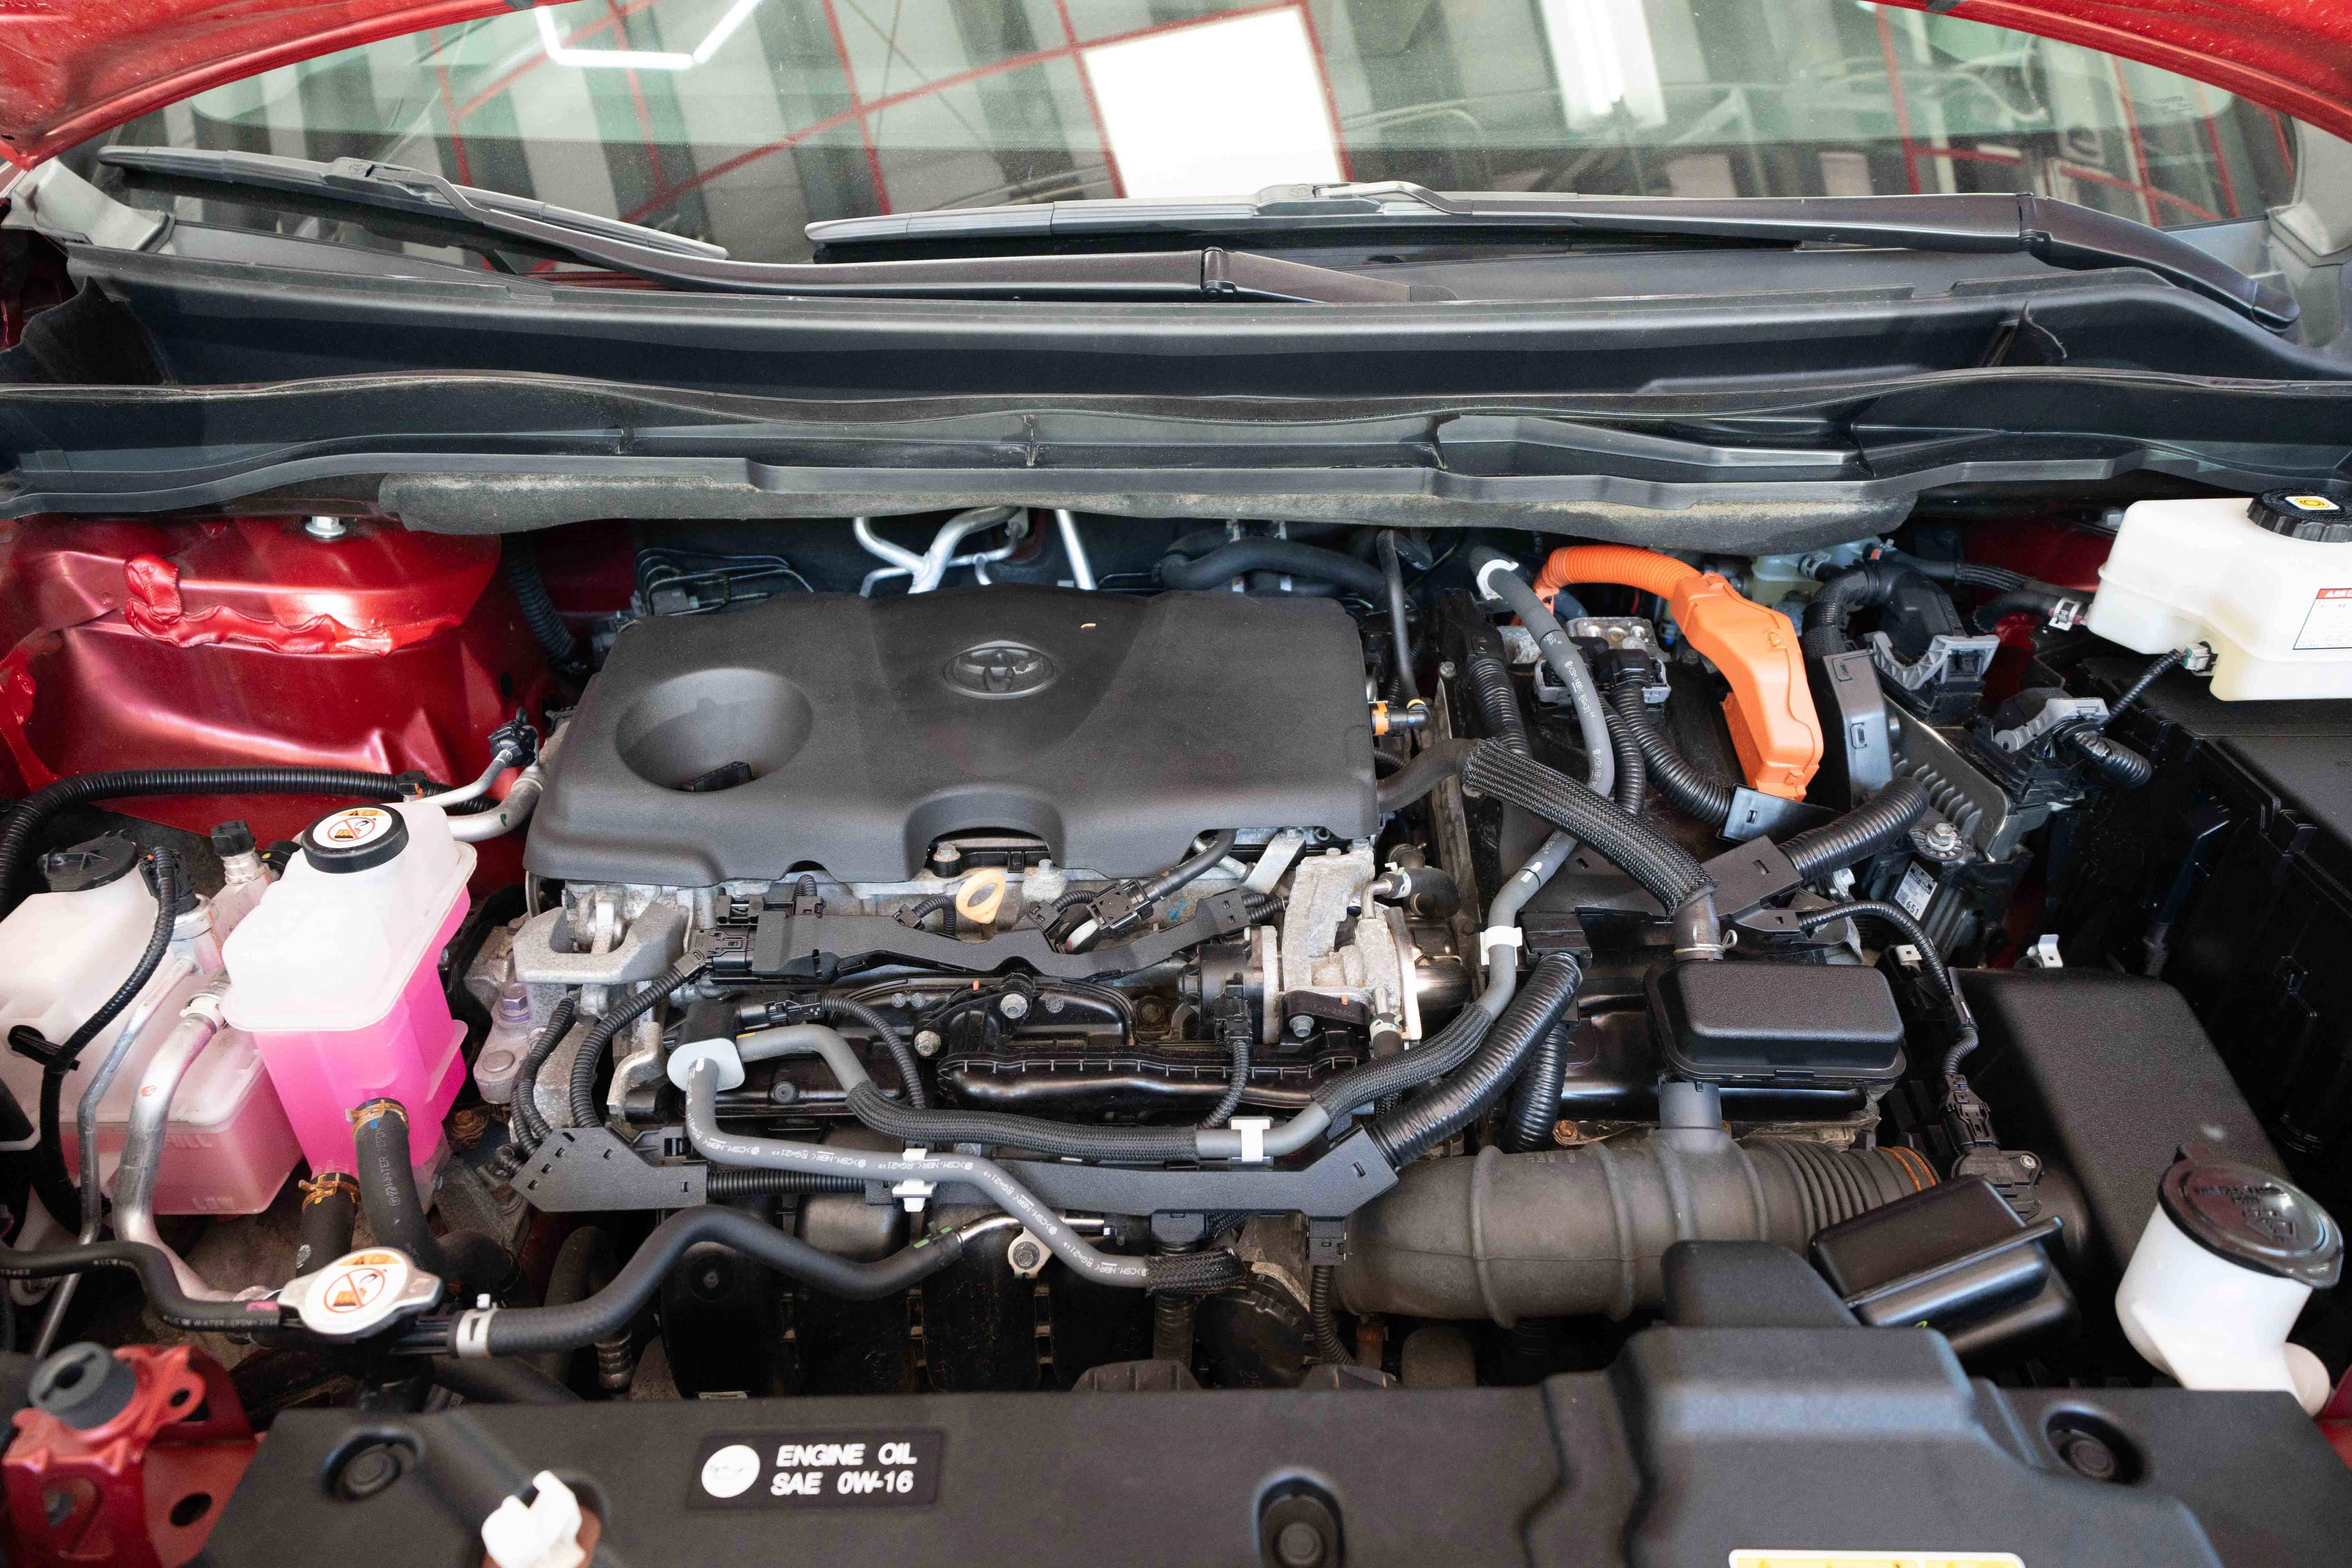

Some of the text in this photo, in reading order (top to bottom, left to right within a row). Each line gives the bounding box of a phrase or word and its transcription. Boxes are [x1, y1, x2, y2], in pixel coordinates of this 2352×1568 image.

[1906, 901, 1919, 916] 651
[379, 1155, 394, 1187] WATER
[776, 1442, 917, 1467] ENGINE OIL
[770, 1470, 914, 1496] SAE 0W-16
